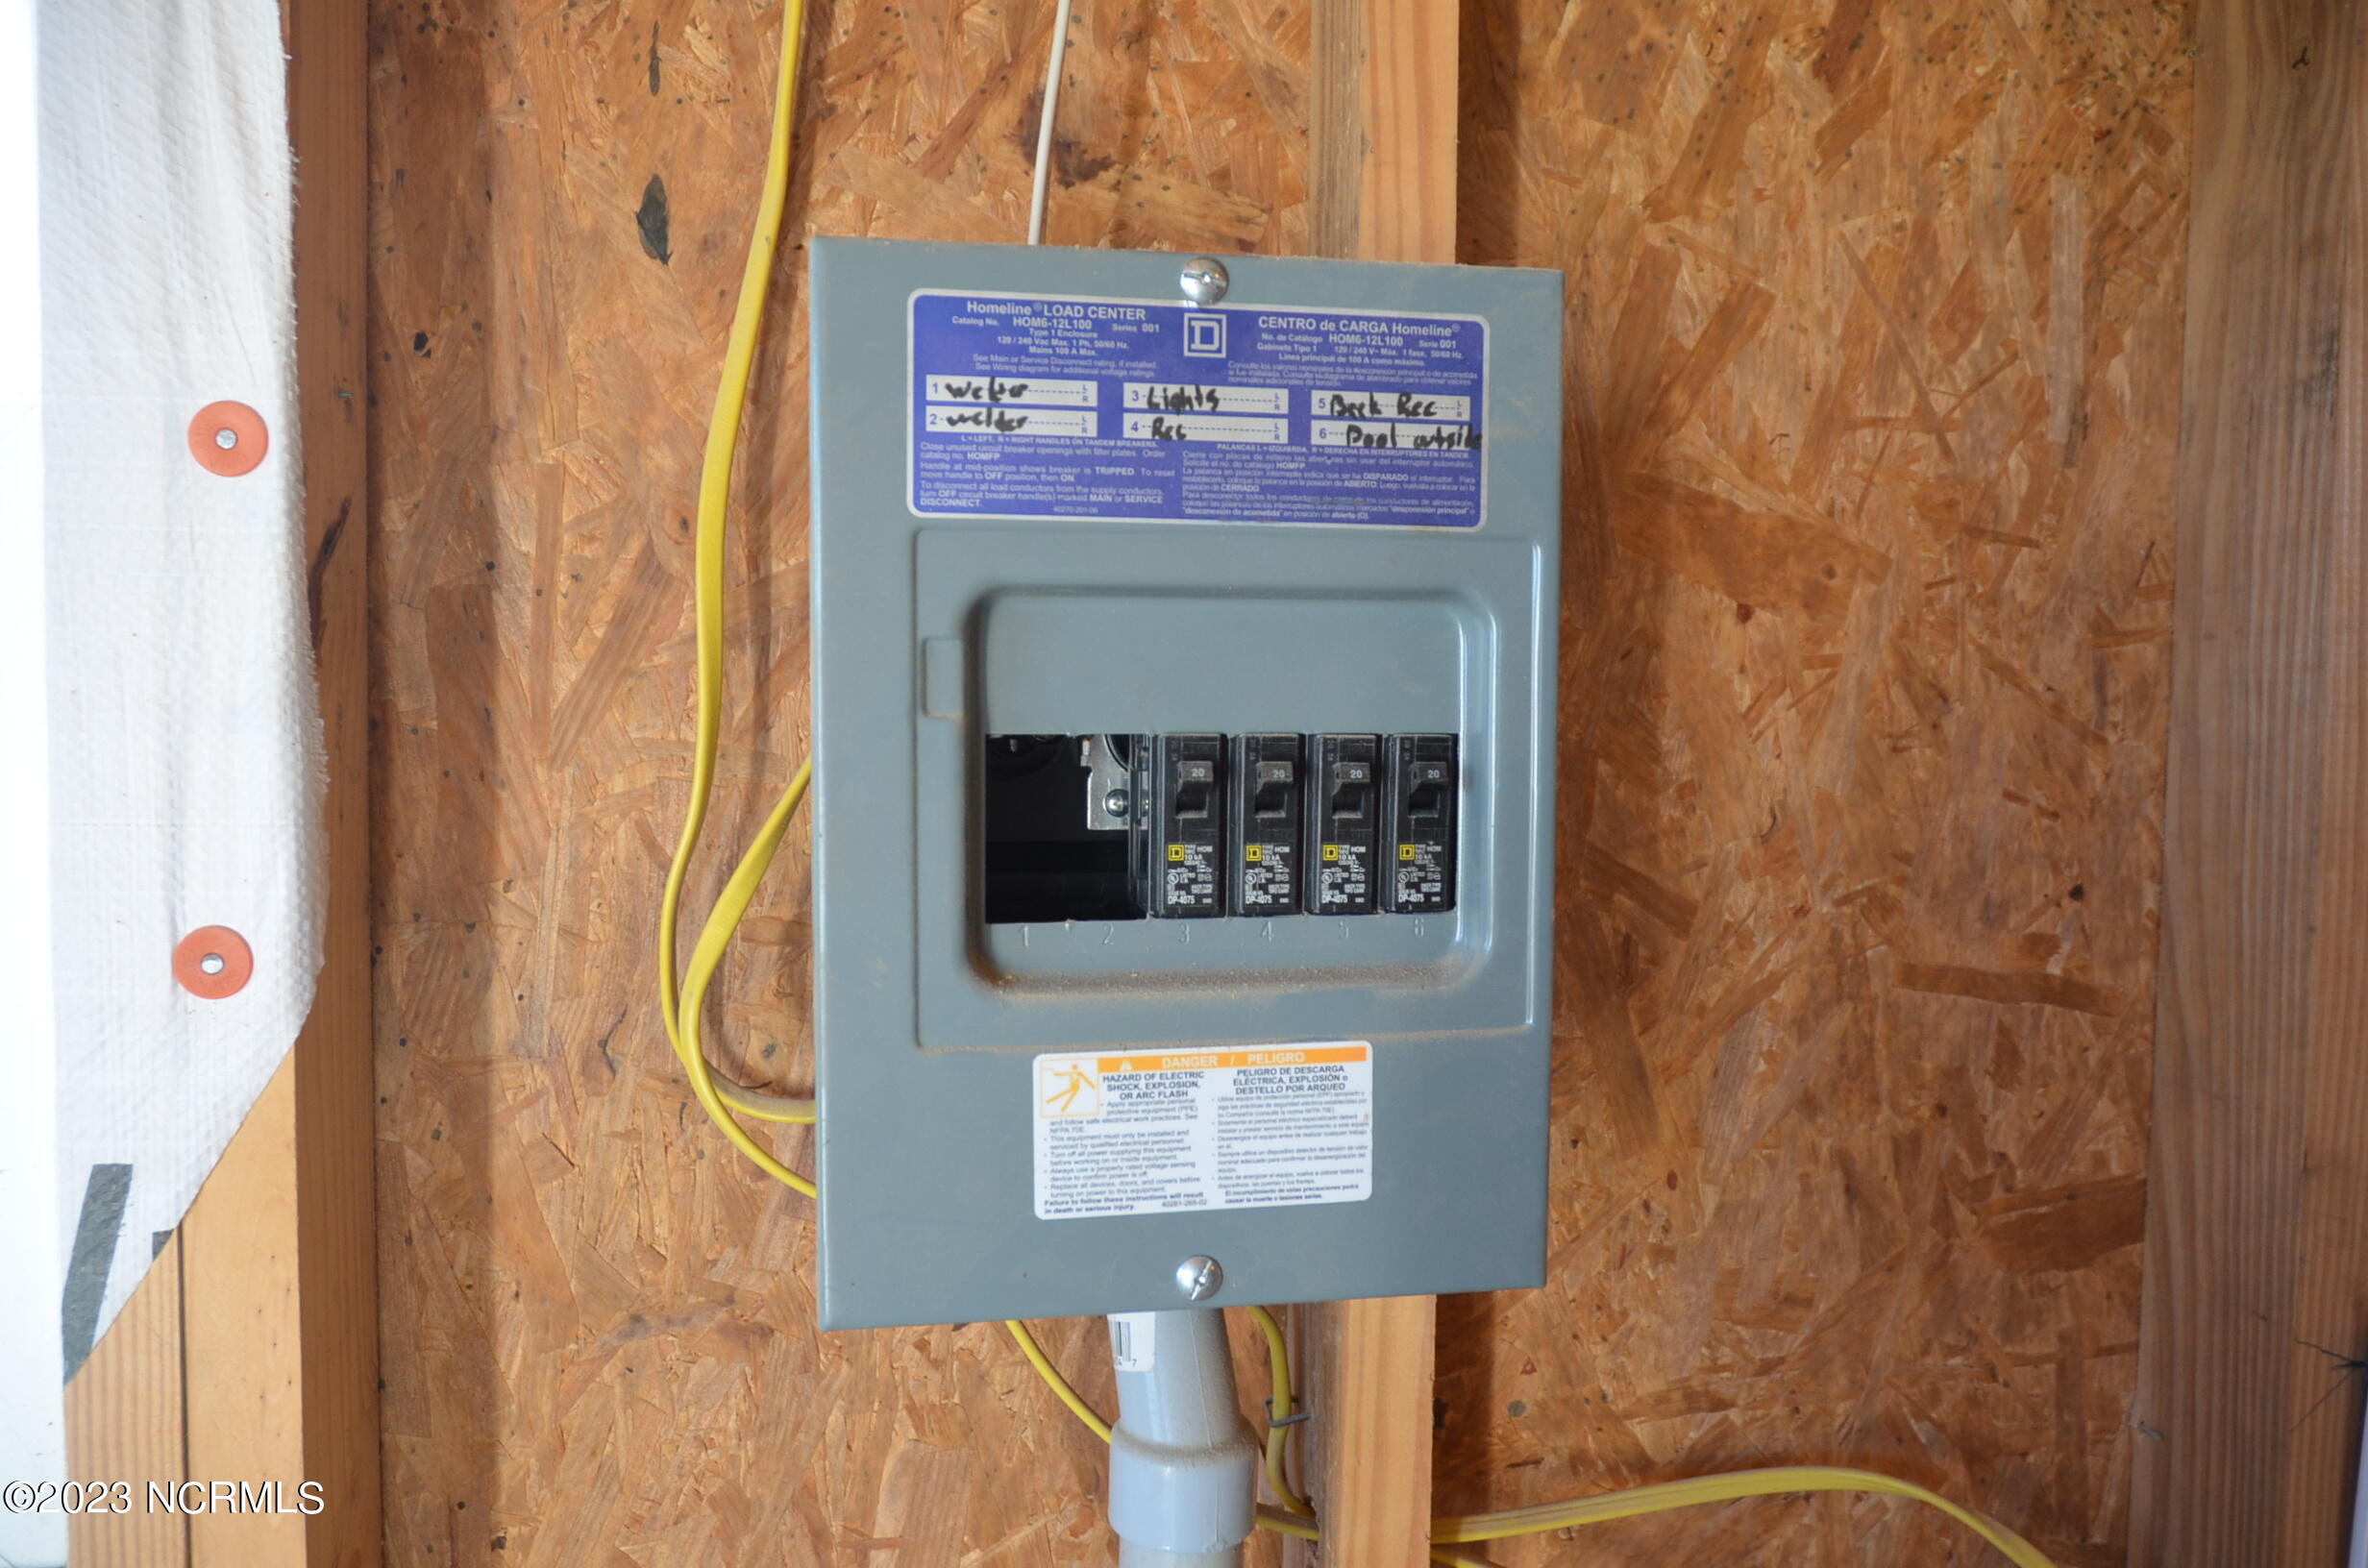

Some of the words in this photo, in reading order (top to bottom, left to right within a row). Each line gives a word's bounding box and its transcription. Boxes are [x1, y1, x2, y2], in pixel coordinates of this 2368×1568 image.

[1044, 304, 1084, 317] LOAD
[1088, 306, 1146, 320] CENTER
[951, 316, 984, 326] Catalog
[985, 317, 999, 326] No.
[1013, 316, 1093, 330] HOM6-12L100
[1112, 323, 1137, 332] Series
[1142, 324, 1159, 332] 001
[1258, 316, 1317, 330] CENTRO
[1320, 319, 1336, 331] de
[1339, 320, 1389, 333] CARGA
[1029, 328, 1048, 337] Type
[1057, 330, 1098, 338] Enclosure
[1257, 342, 1292, 352] Gabinete
[1294, 343, 1311, 353] Tipo
[1261, 332, 1274, 341] No.
[1329, 333, 1403, 347] HOM6-12L100
[1418, 339, 1438, 349] Serie
[1440, 340, 1456, 349] 001
[1029, 346, 1053, 355] Mains
[1079, 348, 1098, 356] Max.
[1345, 422, 1397, 449] Pool
[1192, 768, 1205, 777] 20
[1272, 769, 1285, 778] 20
[1349, 770, 1363, 779] 20
[1427, 770, 1440, 779] 20
[1102, 923, 1114, 945] 2
[1180, 922, 1191, 943] 3
[1260, 919, 1274, 943] 4
[1414, 916, 1425, 938] 6
[1020, 925, 1029, 947] 1
[1162, 1054, 1219, 1068] DANGER
[1247, 1052, 1305, 1065] PELIGRO
[1102, 1072, 1142, 1083] HAZARD
[1144, 1072, 1156, 1081] OF
[1159, 1070, 1204, 1081] ELECTRIC
[1237, 1067, 1277, 1077] PELIGRO
[1279, 1066, 1292, 1075] DE
[1294, 1065, 1344, 1075] DESCARGA
[1119, 1092, 1133, 1101] OR
[1136, 1091, 1155, 1100] ARC
[1158, 1090, 1188, 1098] FLASH
[1236, 1086, 1284, 1095] DESTELLO
[1286, 1084, 1305, 1092] POR
[1307, 1083, 1345, 1093] ARQUEO
